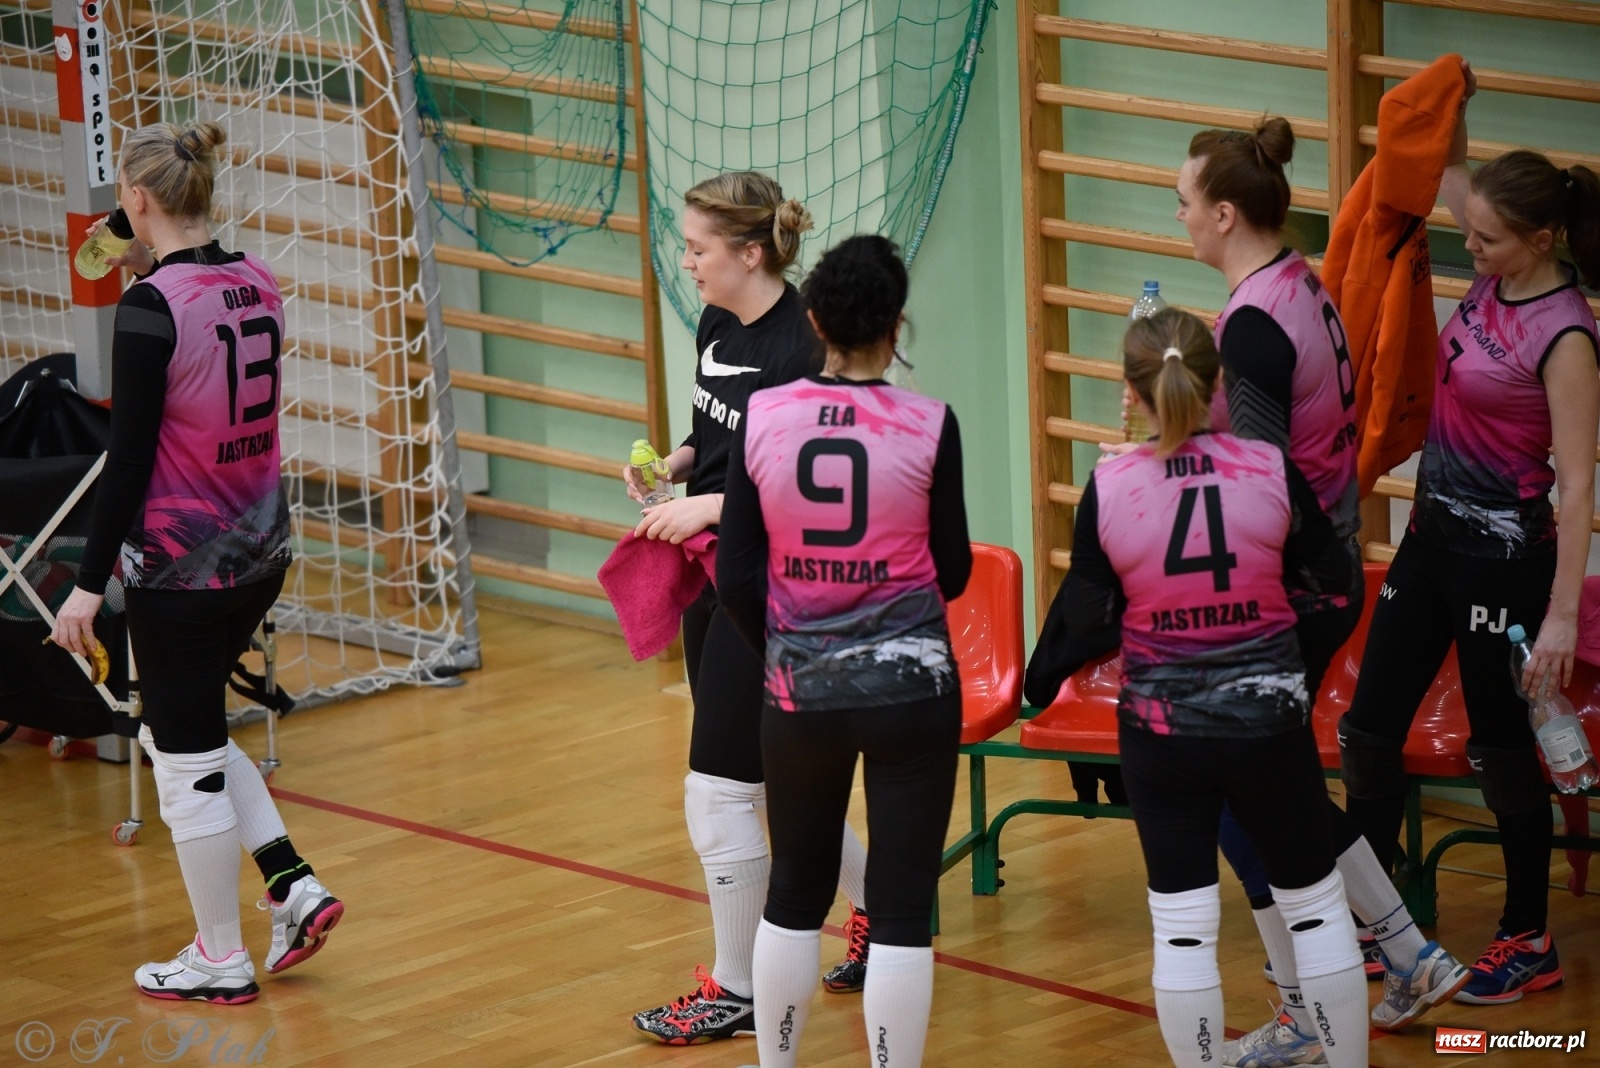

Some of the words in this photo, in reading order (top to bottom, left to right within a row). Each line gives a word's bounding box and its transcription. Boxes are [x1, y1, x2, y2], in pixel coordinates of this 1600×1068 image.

[92, 93, 106, 182] sport
[222, 284, 262, 311] OLGA
[1322, 301, 1355, 412] 8
[1441, 336, 1465, 385] 7
[1468, 323, 1508, 361] POLAND
[215, 315, 281, 427] 13
[692, 383, 713, 413] UST
[709, 397, 727, 424] DO
[727, 408, 742, 431] IT
[817, 405, 857, 427] ELA
[1164, 454, 1216, 479] JULA
[796, 437, 869, 548] 9
[1164, 484, 1238, 593] 4
[1469, 604, 1508, 634] PJ
